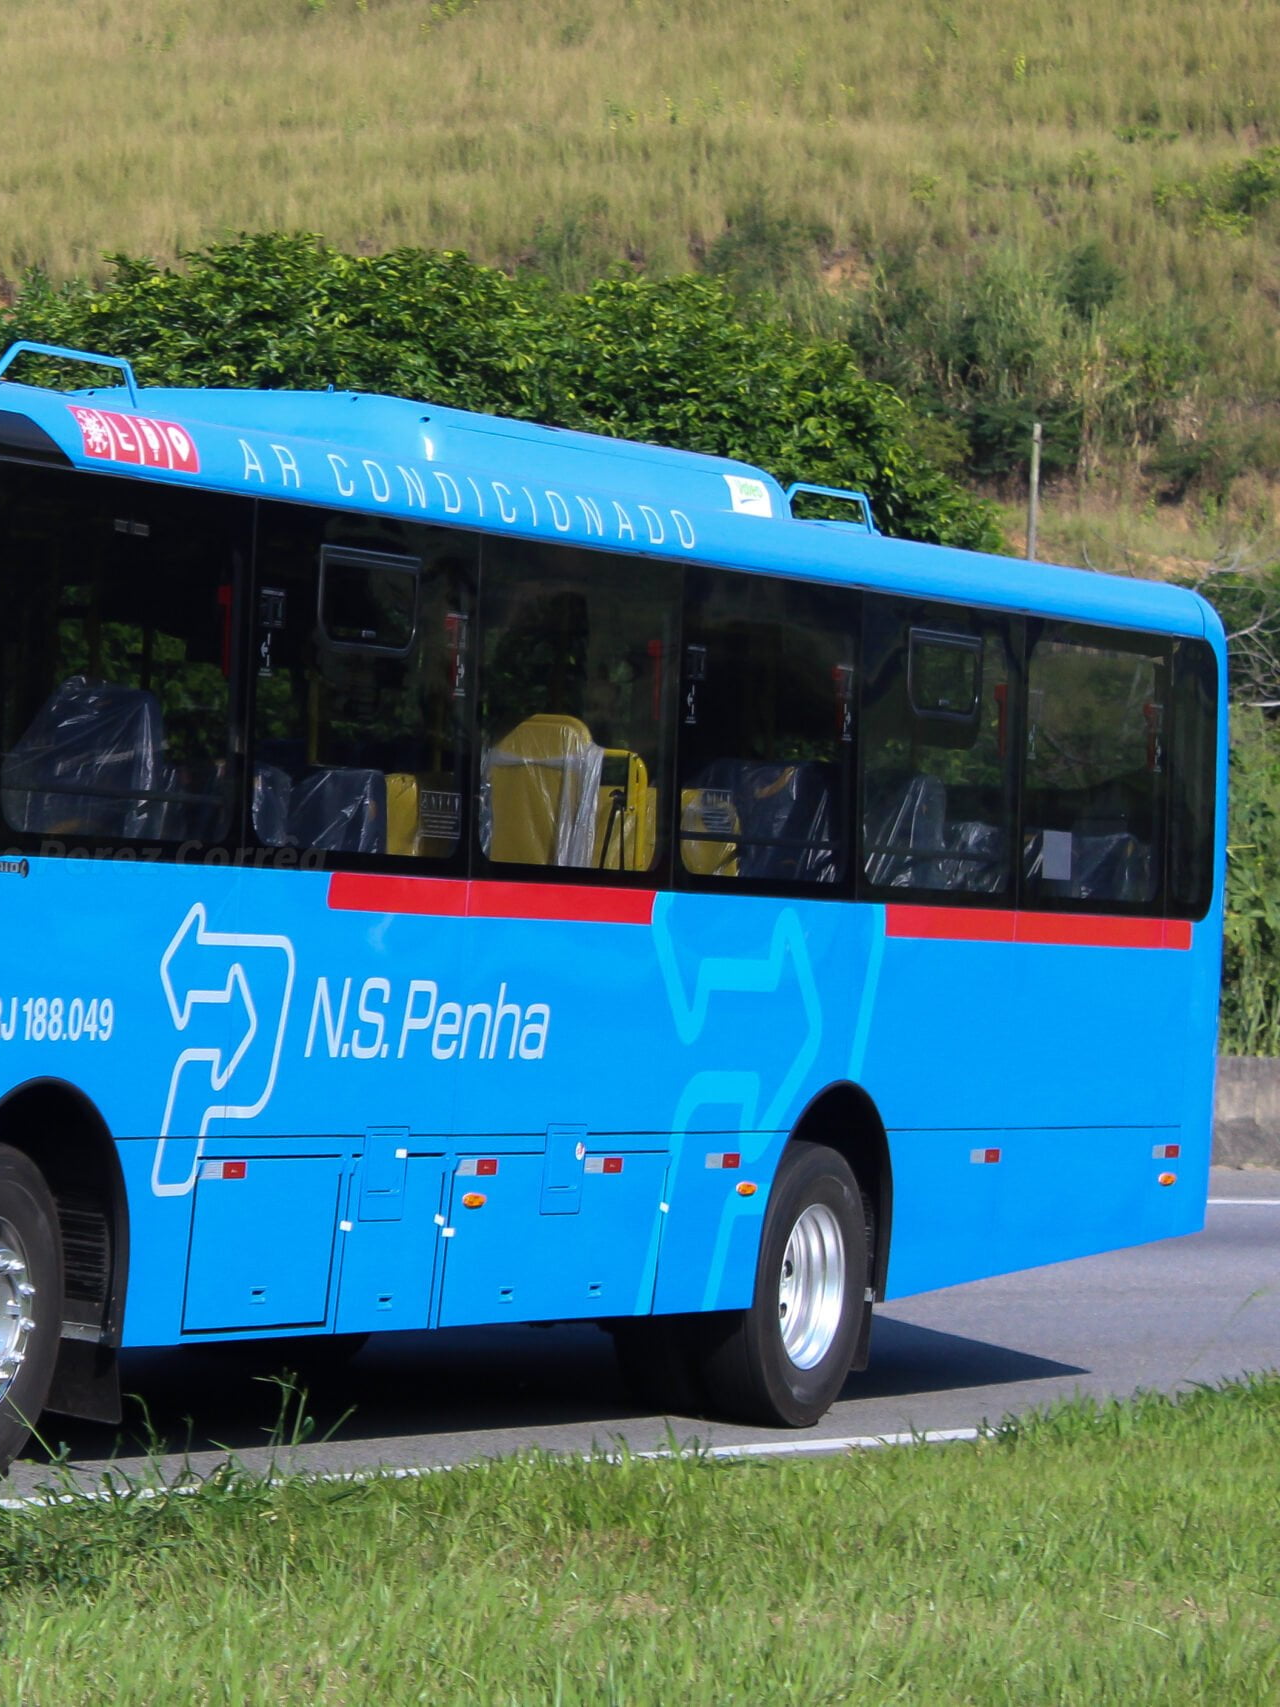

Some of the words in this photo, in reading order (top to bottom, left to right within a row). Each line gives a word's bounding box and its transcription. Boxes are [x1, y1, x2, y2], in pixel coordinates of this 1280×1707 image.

[238, 438, 301, 489] AR
[326, 453, 696, 550] CONDICIONADO
[22, 997, 114, 1042] 188.049
[303, 977, 391, 1059] N.S.
[397, 979, 551, 1060] Penha
